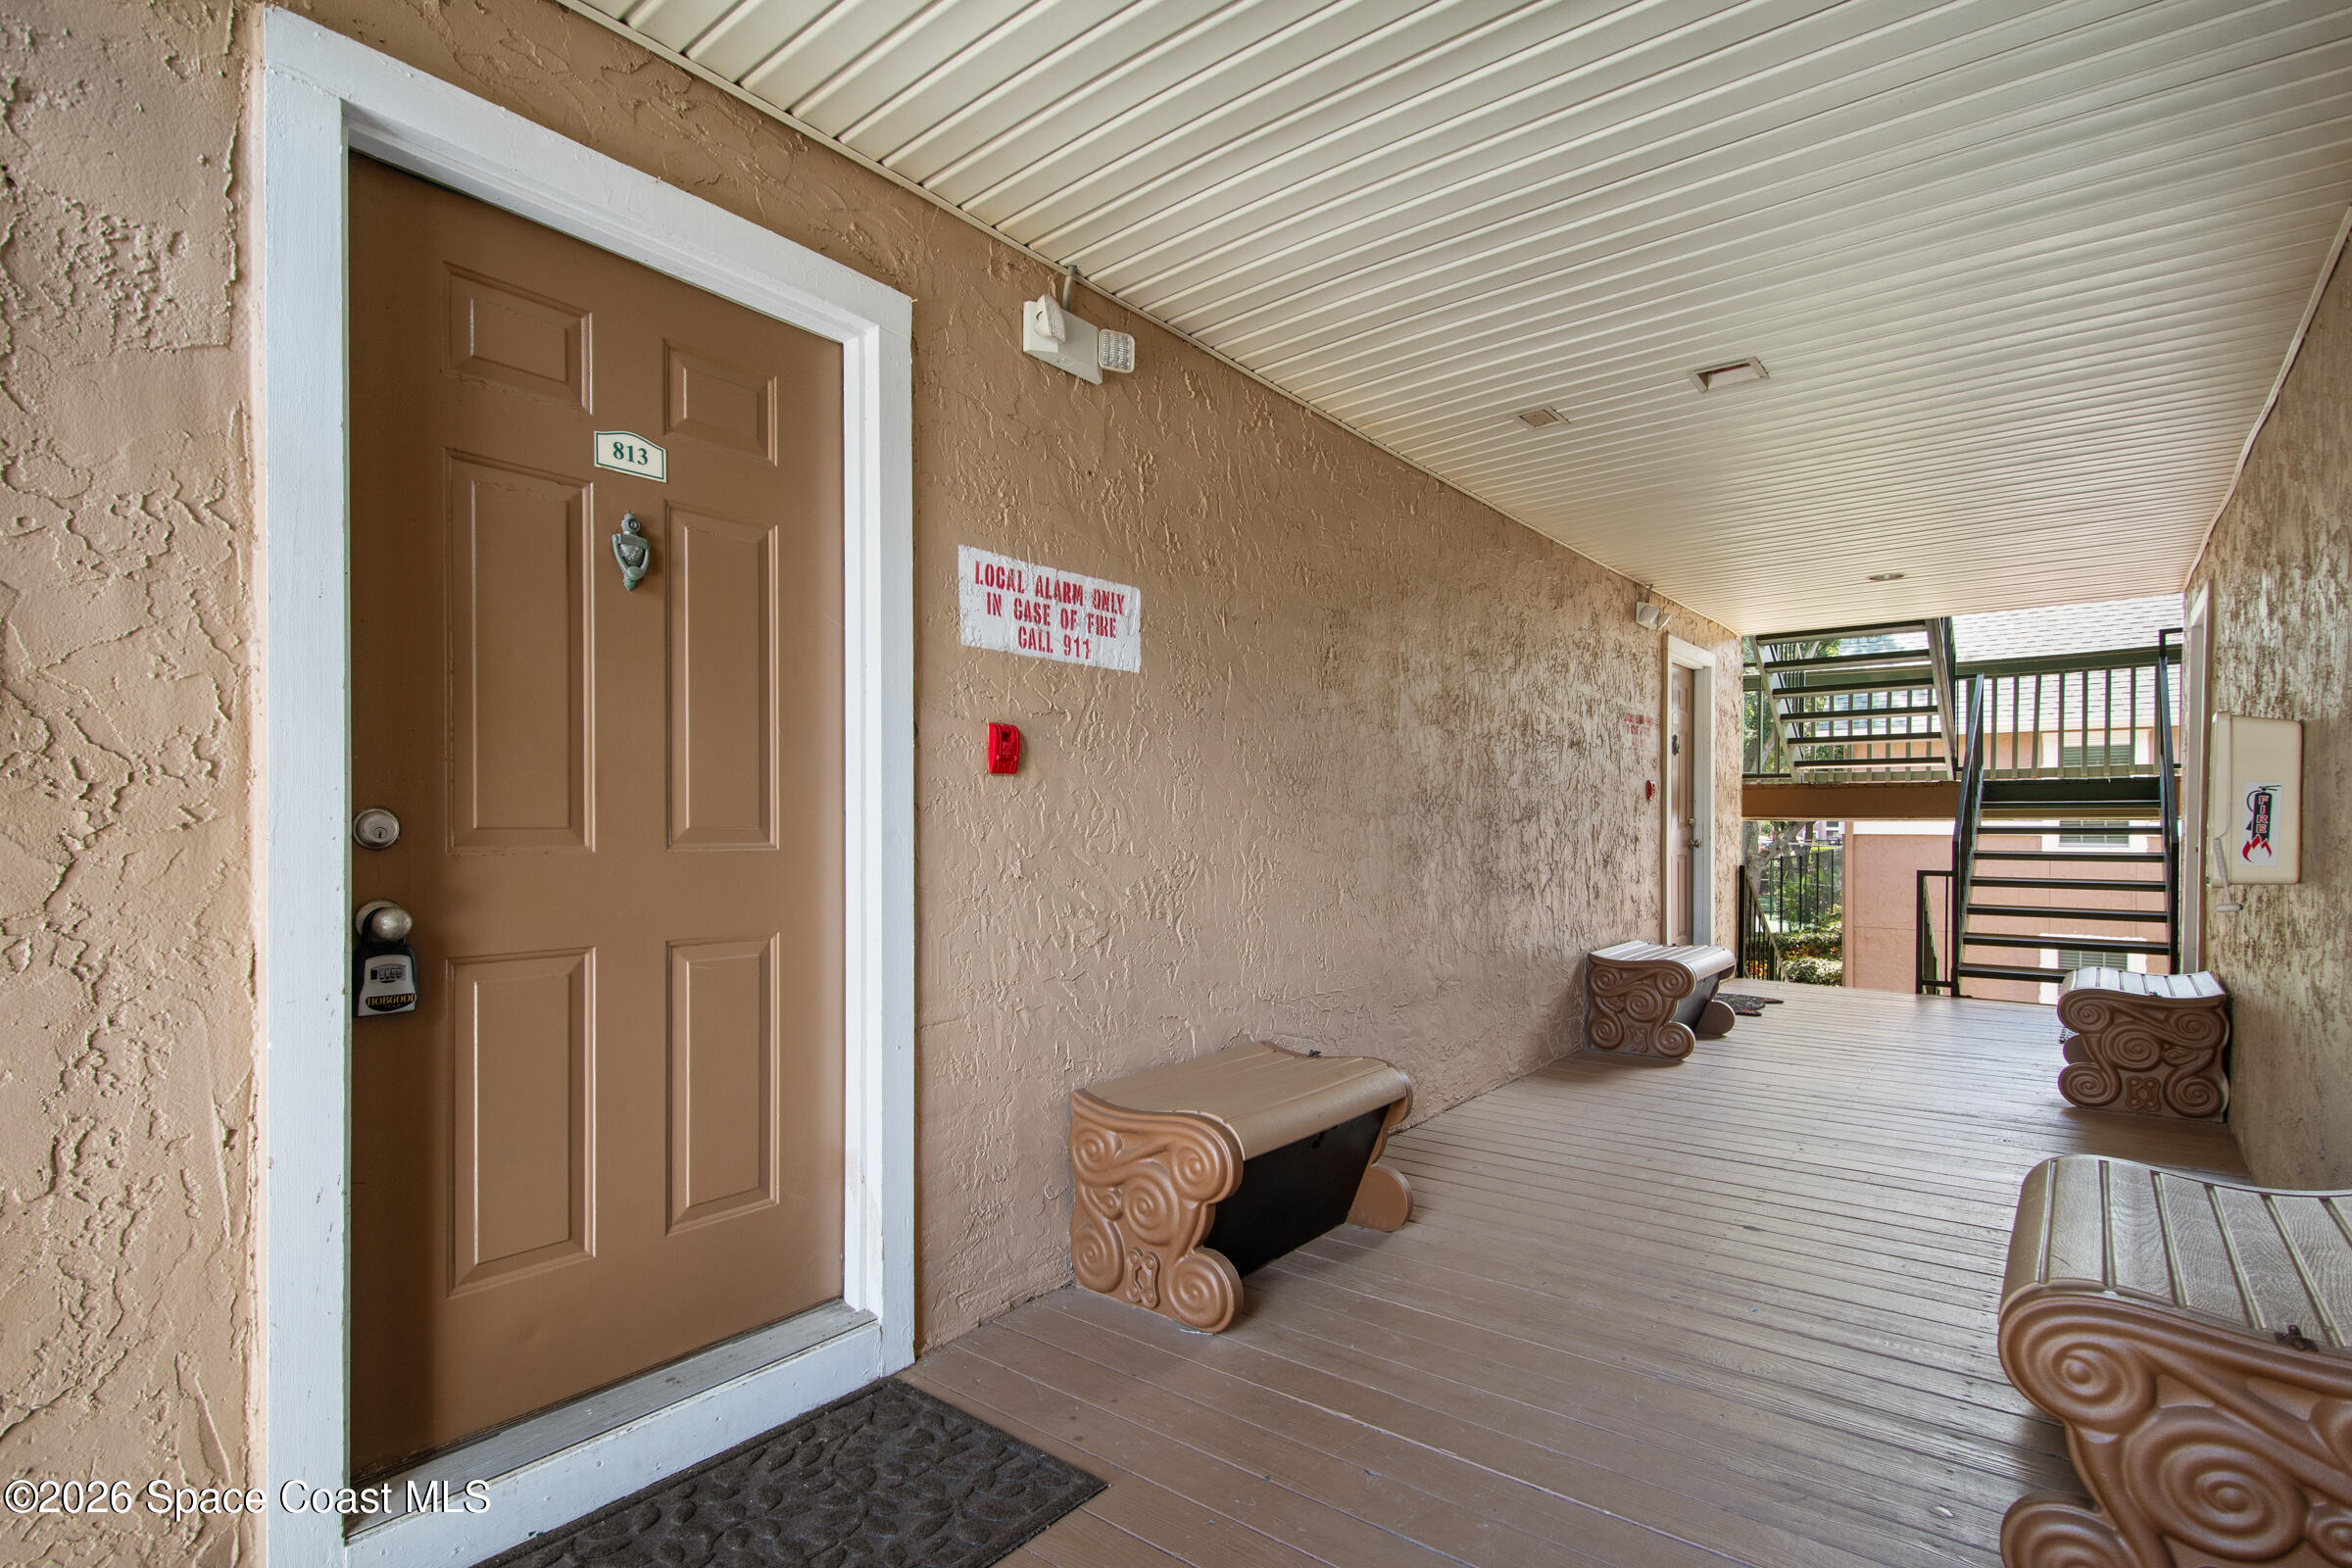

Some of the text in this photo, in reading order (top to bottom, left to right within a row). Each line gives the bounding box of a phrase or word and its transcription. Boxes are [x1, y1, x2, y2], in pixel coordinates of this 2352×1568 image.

[612, 441, 649, 466] 813
[975, 560, 1125, 614] LOCAL ALARM ONLY
[986, 592, 1117, 638] IN CASE OF FIRE
[1017, 625, 1091, 660] CALL 911
[2257, 795, 2270, 833] FIRE
